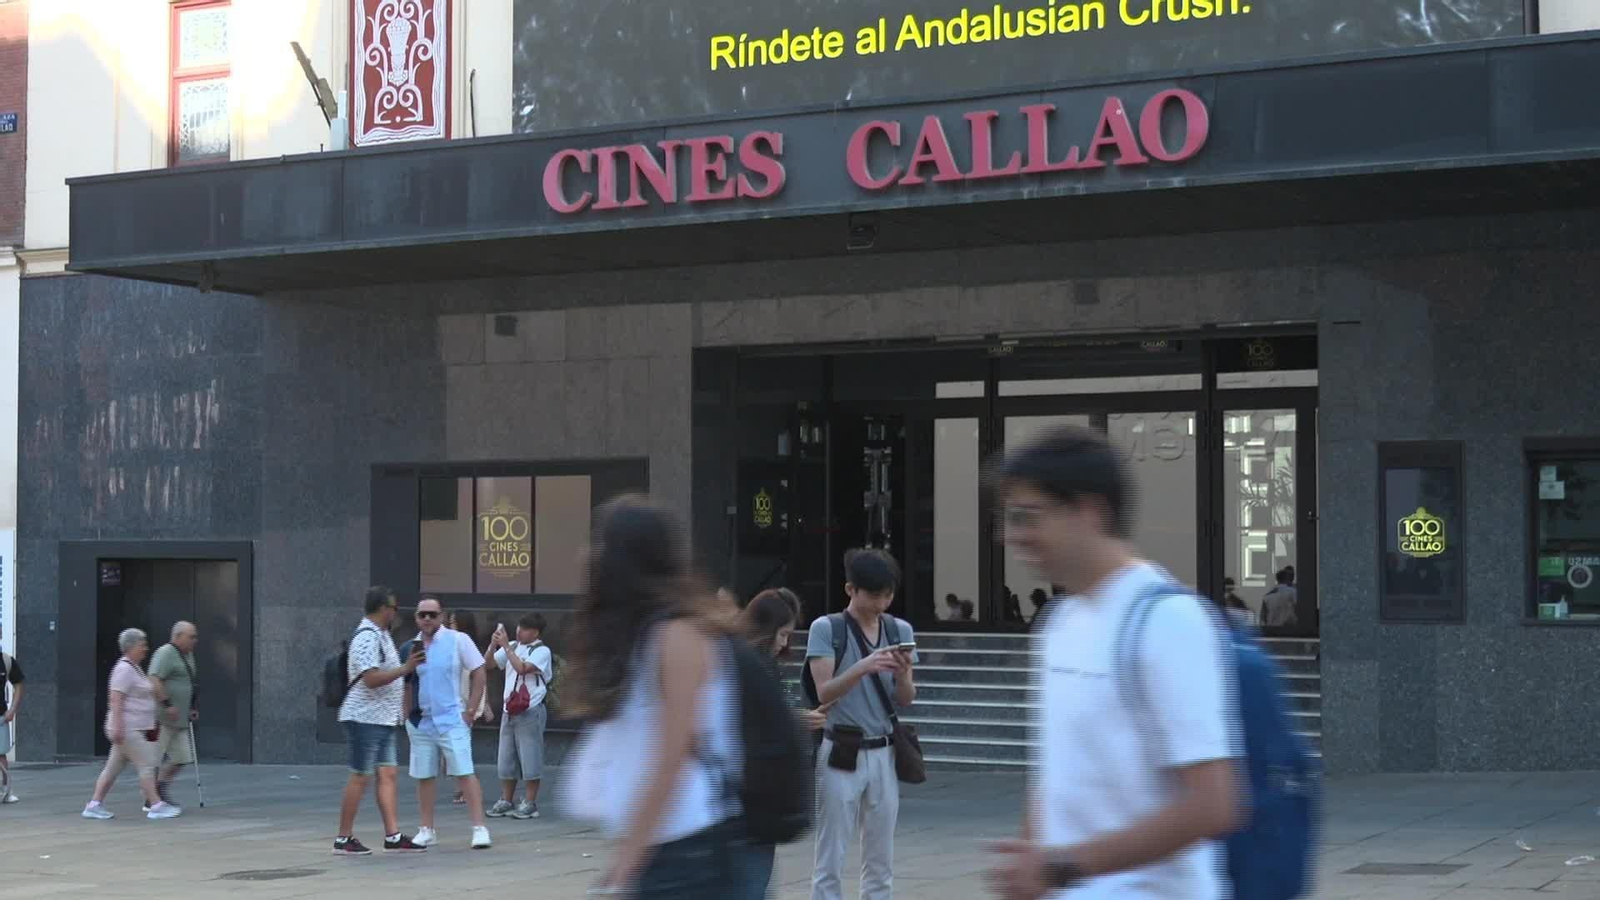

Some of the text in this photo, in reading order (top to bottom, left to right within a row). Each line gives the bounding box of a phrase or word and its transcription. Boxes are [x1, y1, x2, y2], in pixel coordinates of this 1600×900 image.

[710, 27, 846, 70] Ríndete
[855, 17, 887, 55] al
[895, 0, 1106, 50] Andalusian
[543, 88, 1209, 214] CINES CALLAO
[756, 498, 770, 510] 100
[481, 516, 528, 541] 100
[1403, 520, 1440, 535] 100
[490, 542, 519, 552] CINES
[1401, 542, 1442, 551] CALLAO
[480, 552, 530, 567] CALLAO
